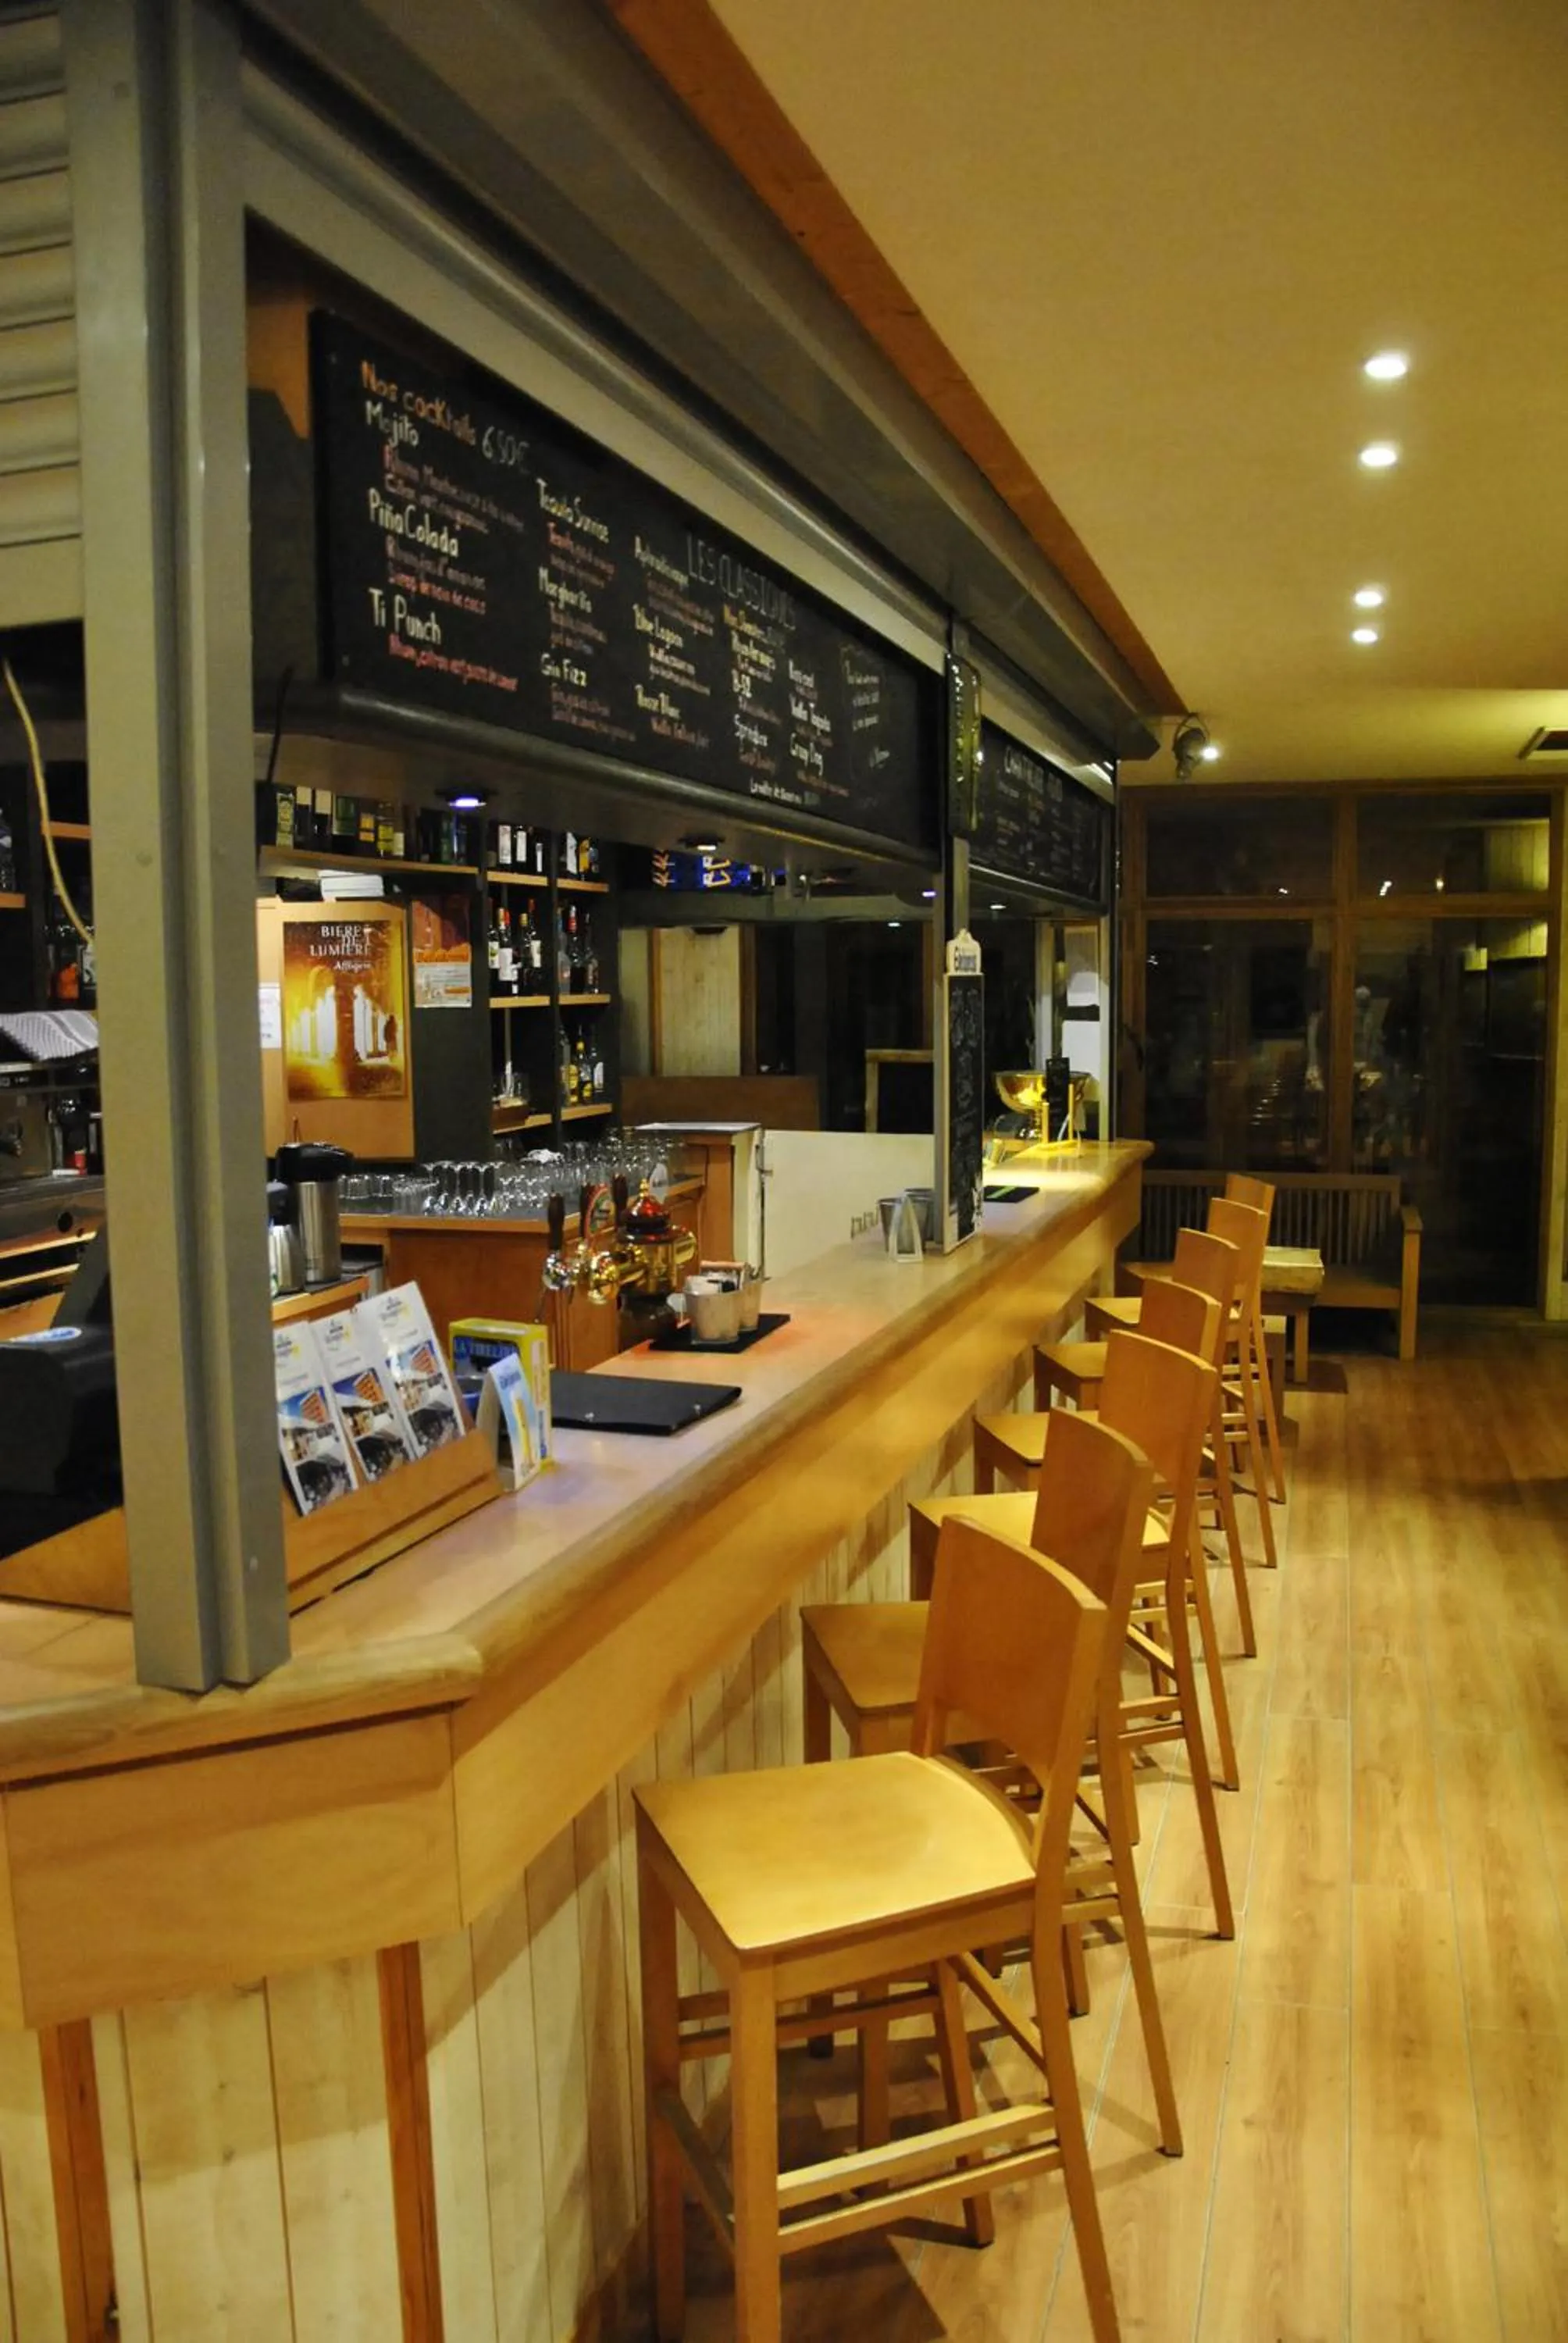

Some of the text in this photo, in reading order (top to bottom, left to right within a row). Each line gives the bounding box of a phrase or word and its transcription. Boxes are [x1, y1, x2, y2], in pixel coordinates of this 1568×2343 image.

[365, 399, 419, 448] Mojito
[368, 487, 404, 534] Piña
[404, 504, 459, 558] Colada
[368, 587, 387, 628] Ti
[394, 593, 442, 645] Punch
[540, 652, 561, 678] Gin
[562, 658, 587, 687] Fizz
